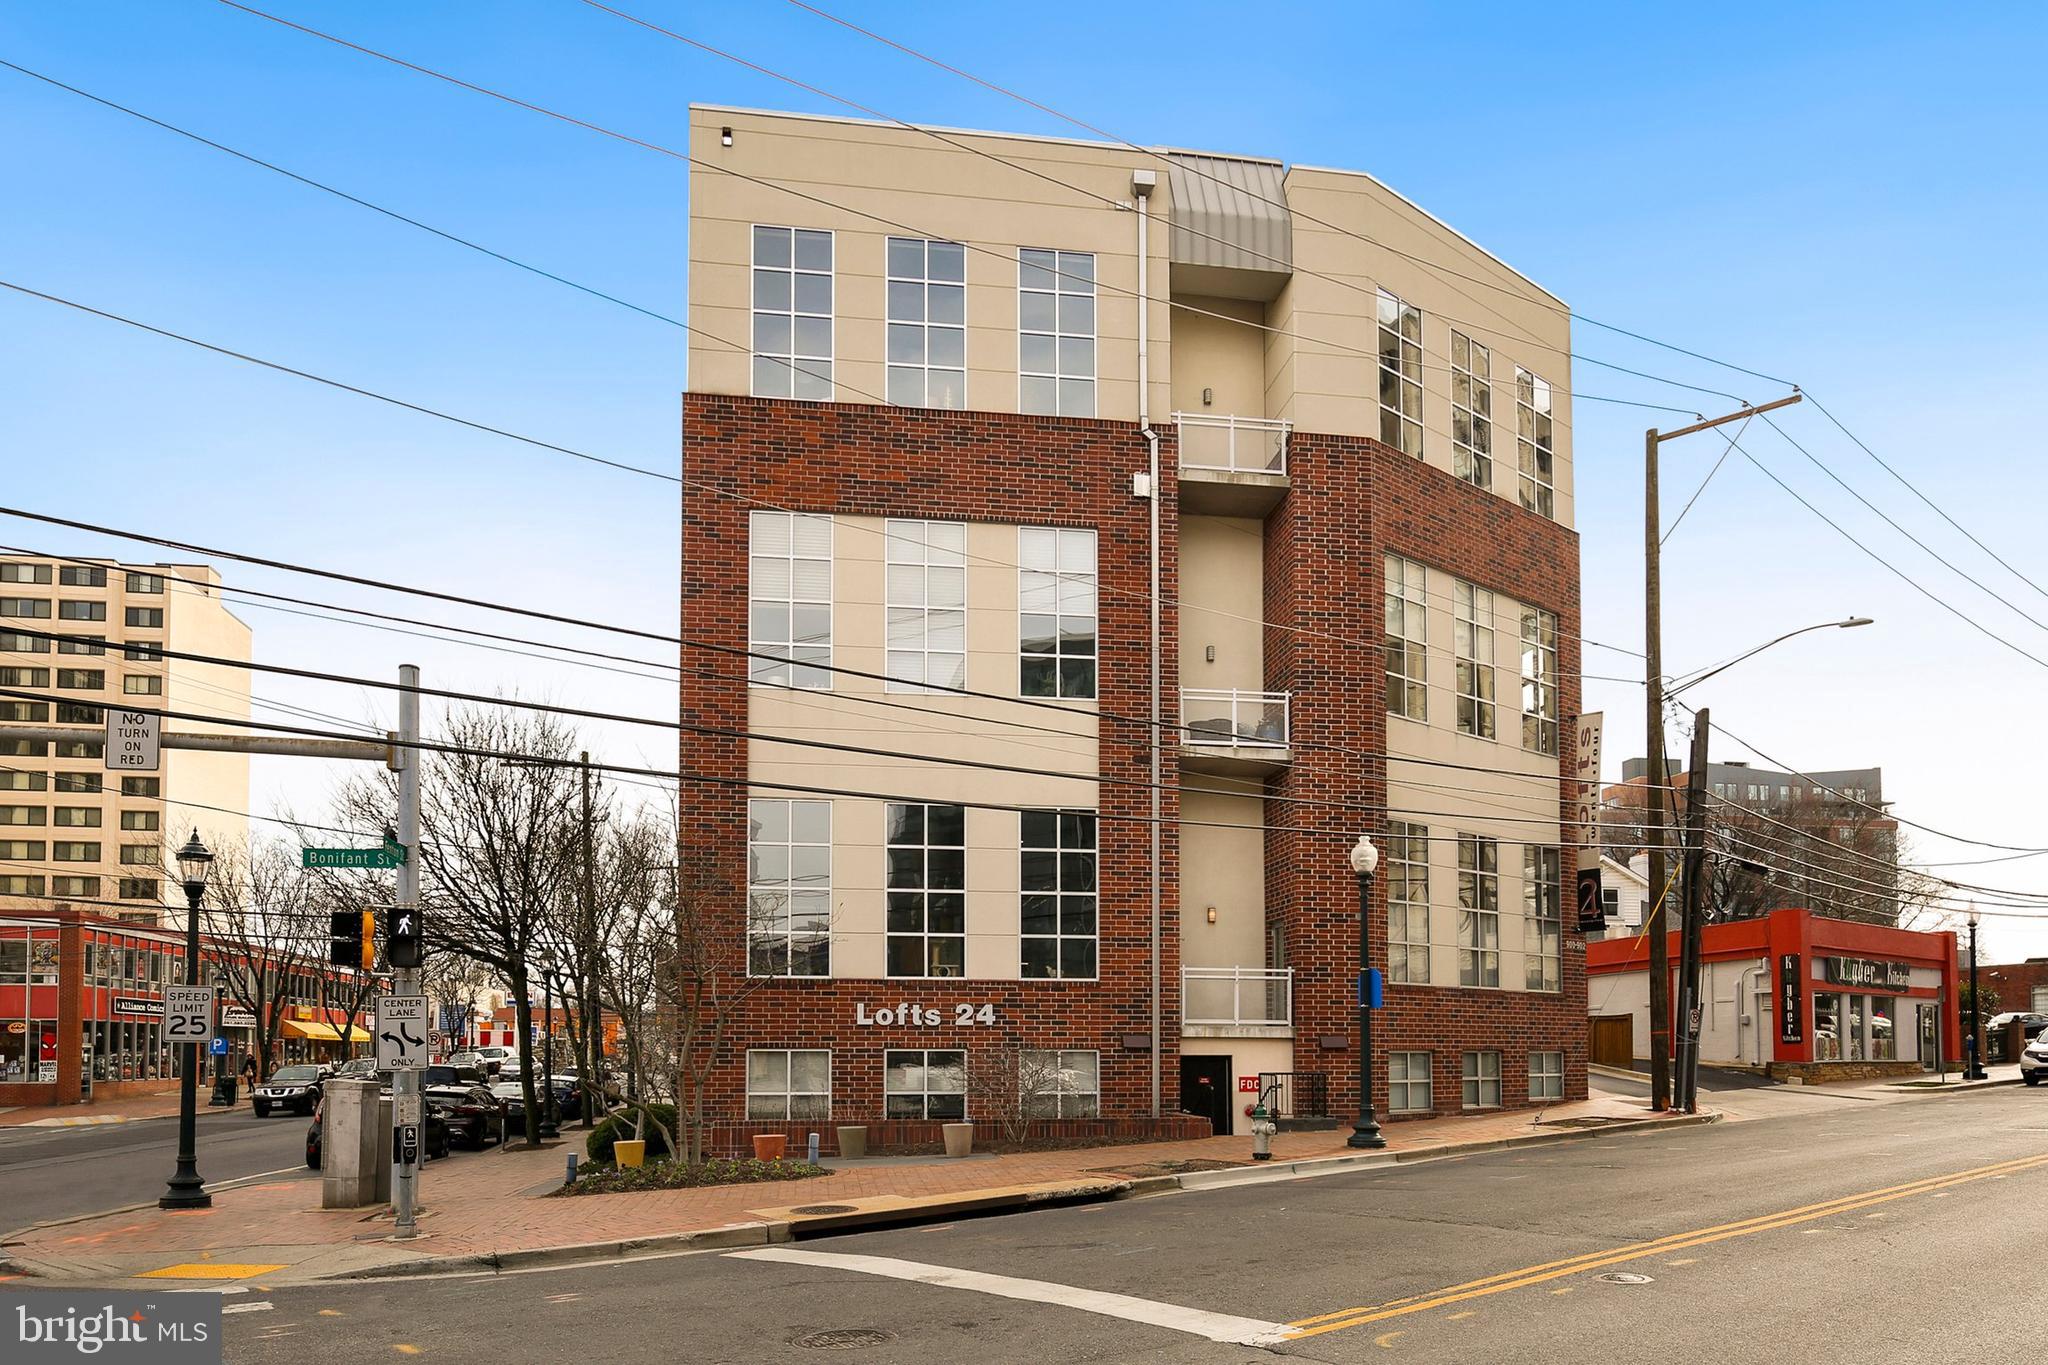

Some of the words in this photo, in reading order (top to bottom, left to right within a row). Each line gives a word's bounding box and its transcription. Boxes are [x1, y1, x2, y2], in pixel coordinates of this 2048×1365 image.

[122, 713, 145, 725] NO
[118, 728, 149, 738] TURN
[125, 741, 141, 751] ON
[121, 755, 144, 764] RED
[310, 852, 368, 865] Bonifant
[170, 992, 209, 1001] SPEED
[121, 1001, 146, 1011] Alliance
[173, 1003, 204, 1012] LIMIT
[384, 999, 422, 1007] CENTER
[390, 1008, 416, 1016] LANE
[857, 1003, 941, 1026] Lofts
[955, 1003, 996, 1026] 24
[169, 1015, 207, 1035] 25
[213, 1038, 222, 1050] P
[391, 1058, 415, 1066] ONLY
[1240, 1080, 1259, 1089] FDC
